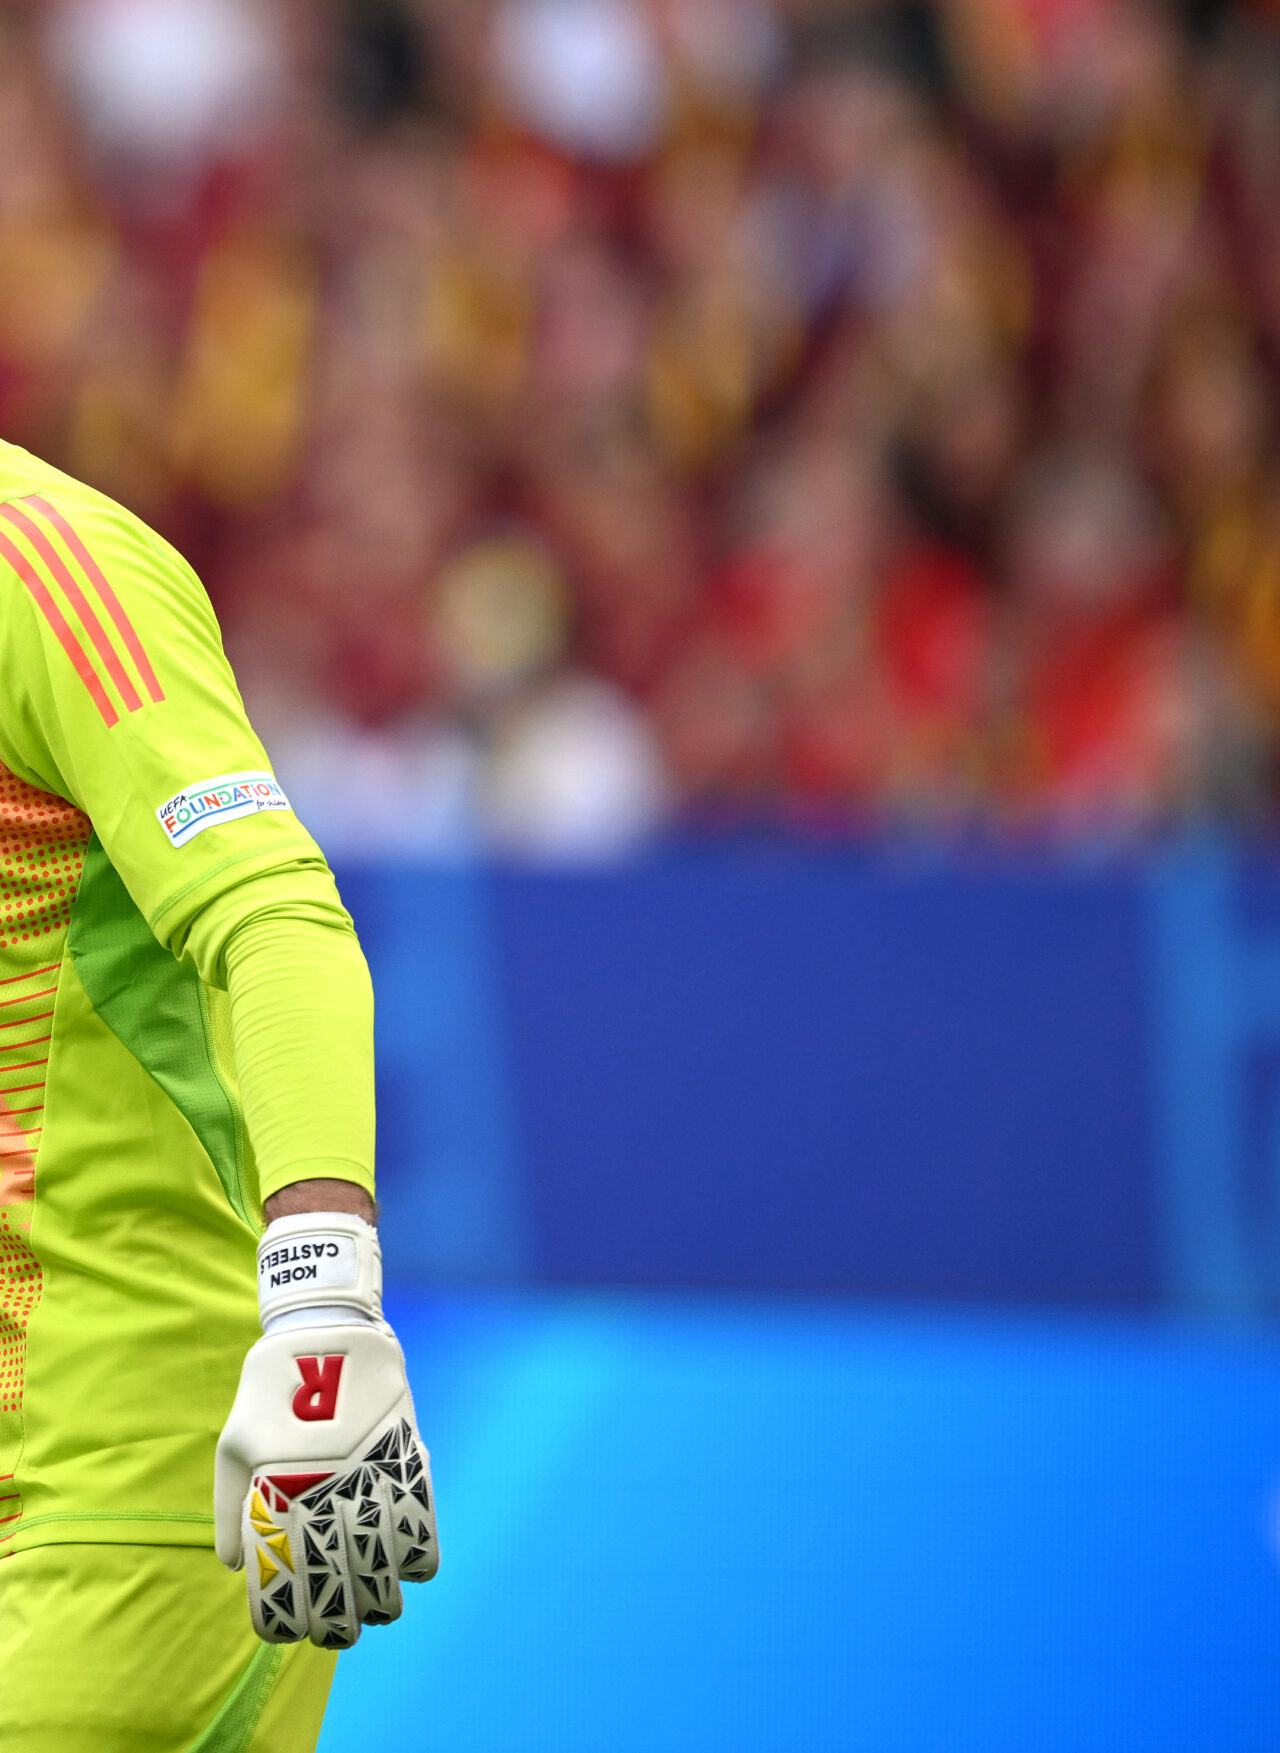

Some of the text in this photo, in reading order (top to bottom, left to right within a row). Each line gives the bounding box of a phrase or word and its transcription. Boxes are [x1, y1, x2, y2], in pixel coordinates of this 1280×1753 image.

[160, 794, 187, 819] UEFA
[261, 1243, 339, 1276] CASTEELS
[271, 1264, 317, 1289] KOEN
[292, 1355, 345, 1422] R
